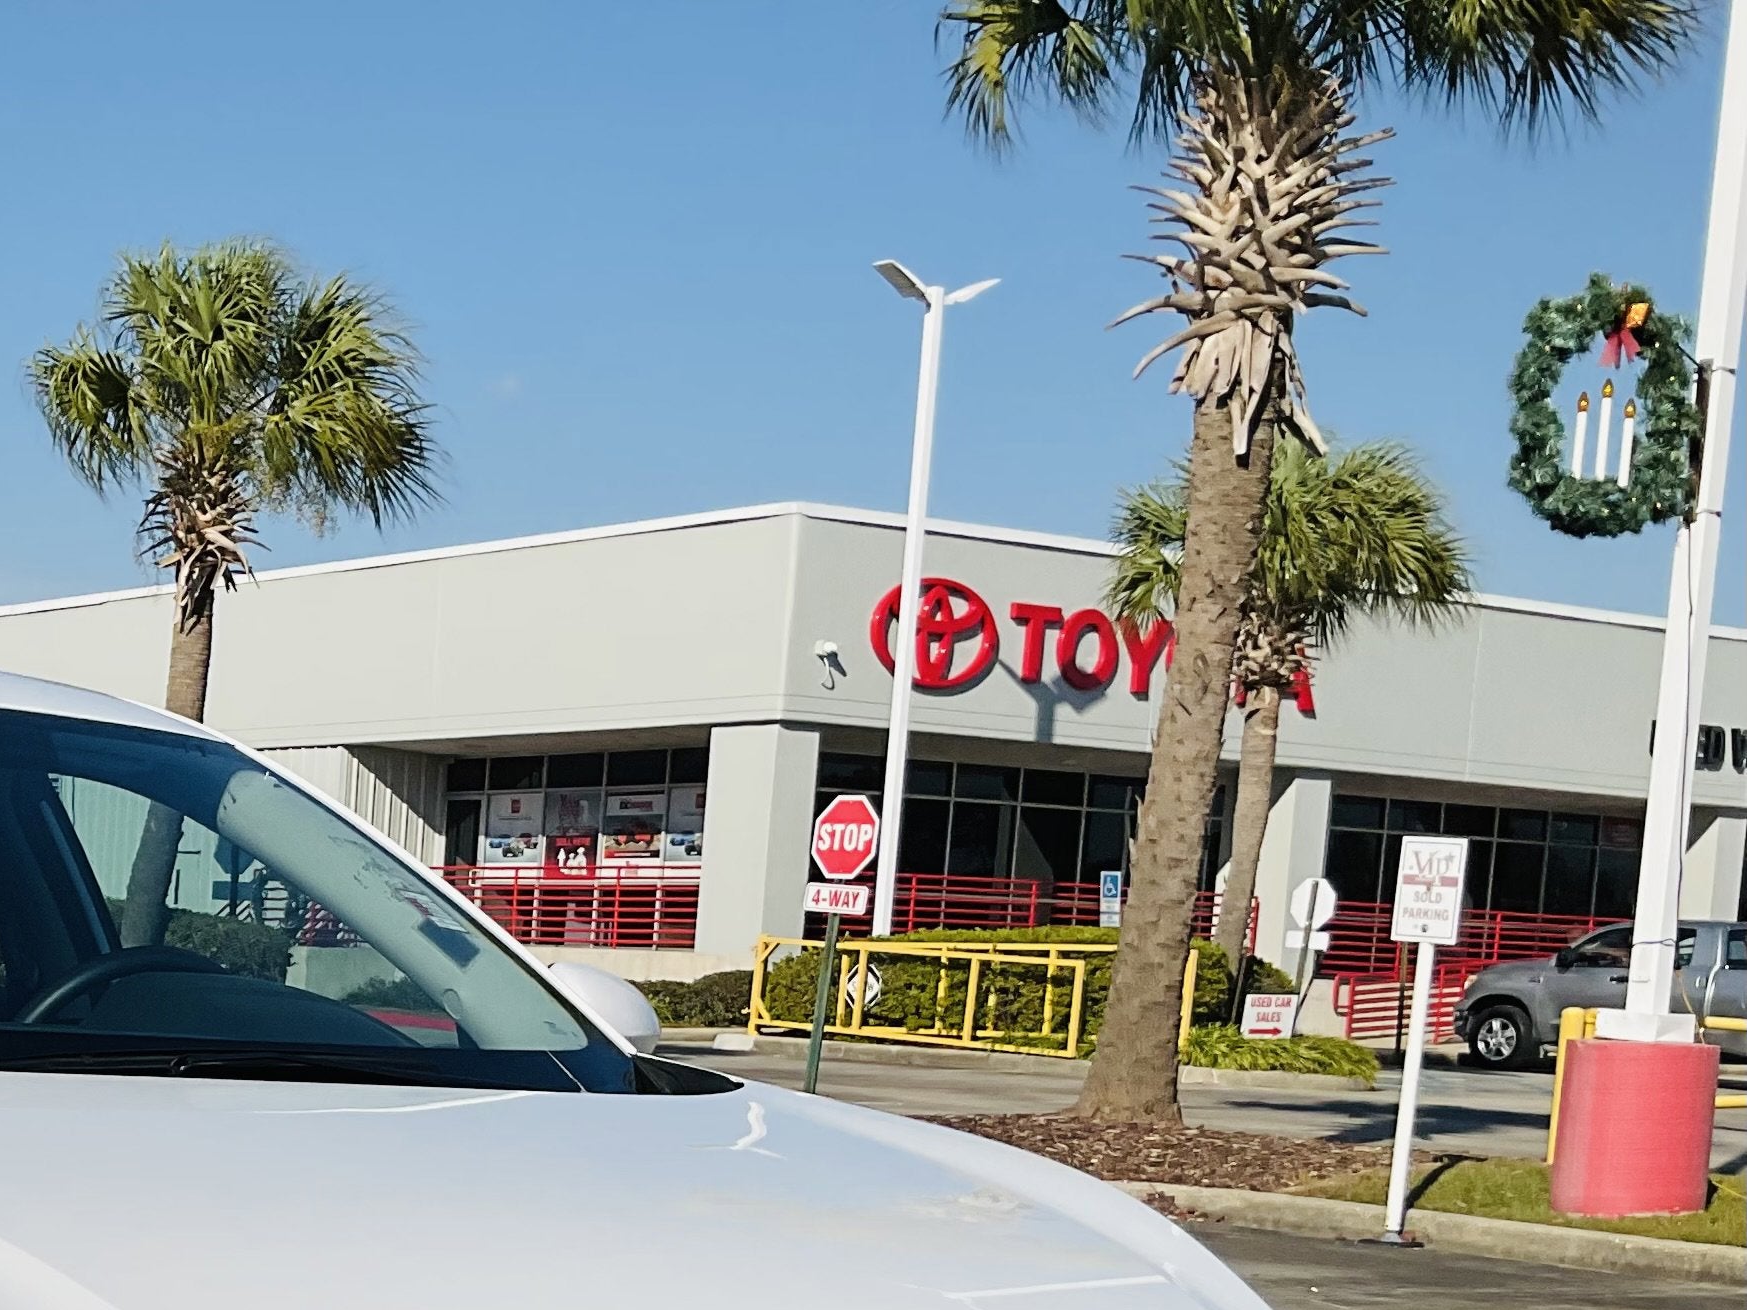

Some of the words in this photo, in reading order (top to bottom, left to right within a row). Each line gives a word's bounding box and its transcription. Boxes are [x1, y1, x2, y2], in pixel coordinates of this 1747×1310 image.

[817, 823, 873, 852] STOP
[812, 888, 860, 909] 4-WAY
[1412, 890, 1442, 904] SOLD
[1402, 907, 1450, 921] PARKING
[1251, 997, 1272, 1008] USED
[1275, 997, 1292, 1008] CAR
[1256, 1012, 1282, 1023] SALES
